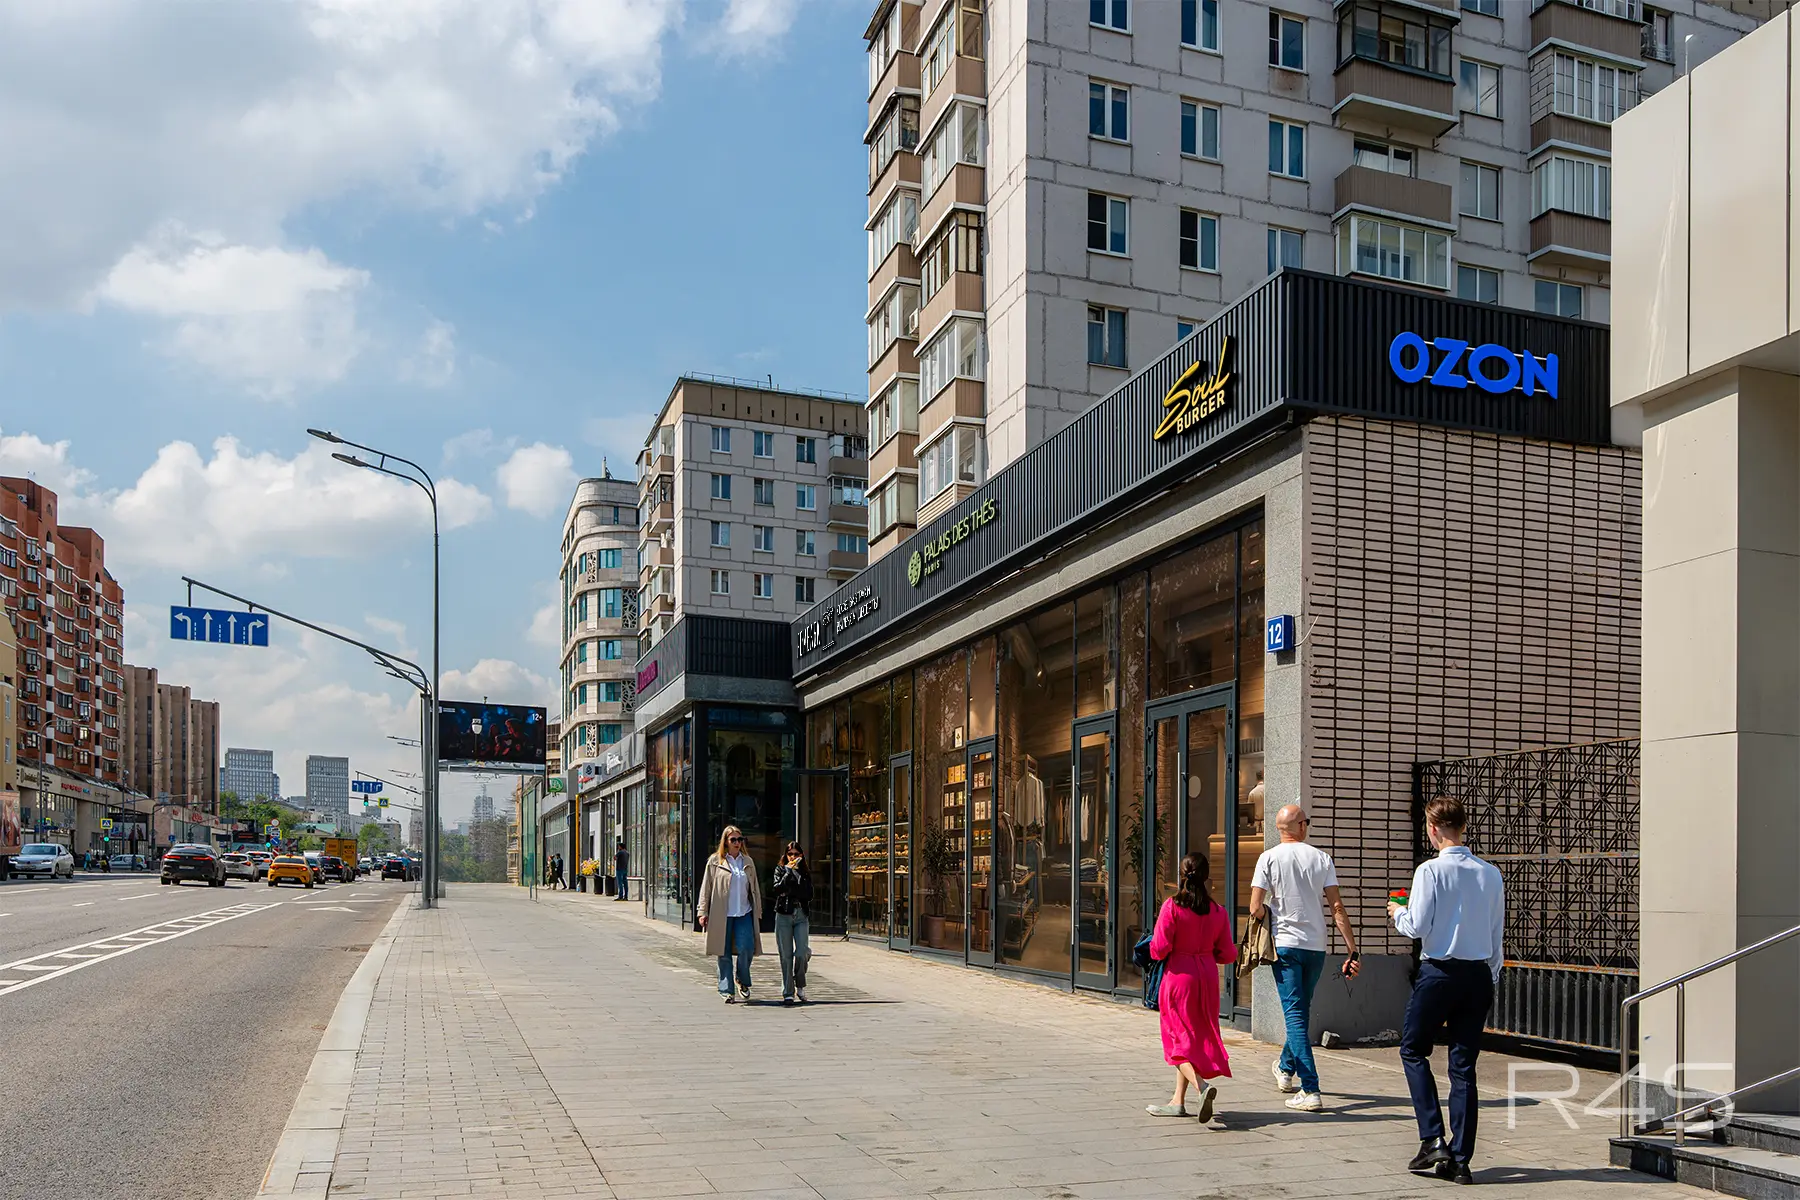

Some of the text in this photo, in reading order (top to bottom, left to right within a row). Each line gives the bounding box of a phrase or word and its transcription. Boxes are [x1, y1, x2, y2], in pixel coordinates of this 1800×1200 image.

[1153, 335, 1230, 440] Soul
[1389, 331, 1559, 400] OZON
[1176, 389, 1225, 434] BURGER
[924, 498, 996, 563] PALAIS DES THÉS
[924, 559, 940, 577] PARIS
[1268, 622, 1282, 645] 12
[531, 713, 543, 721] 12+
